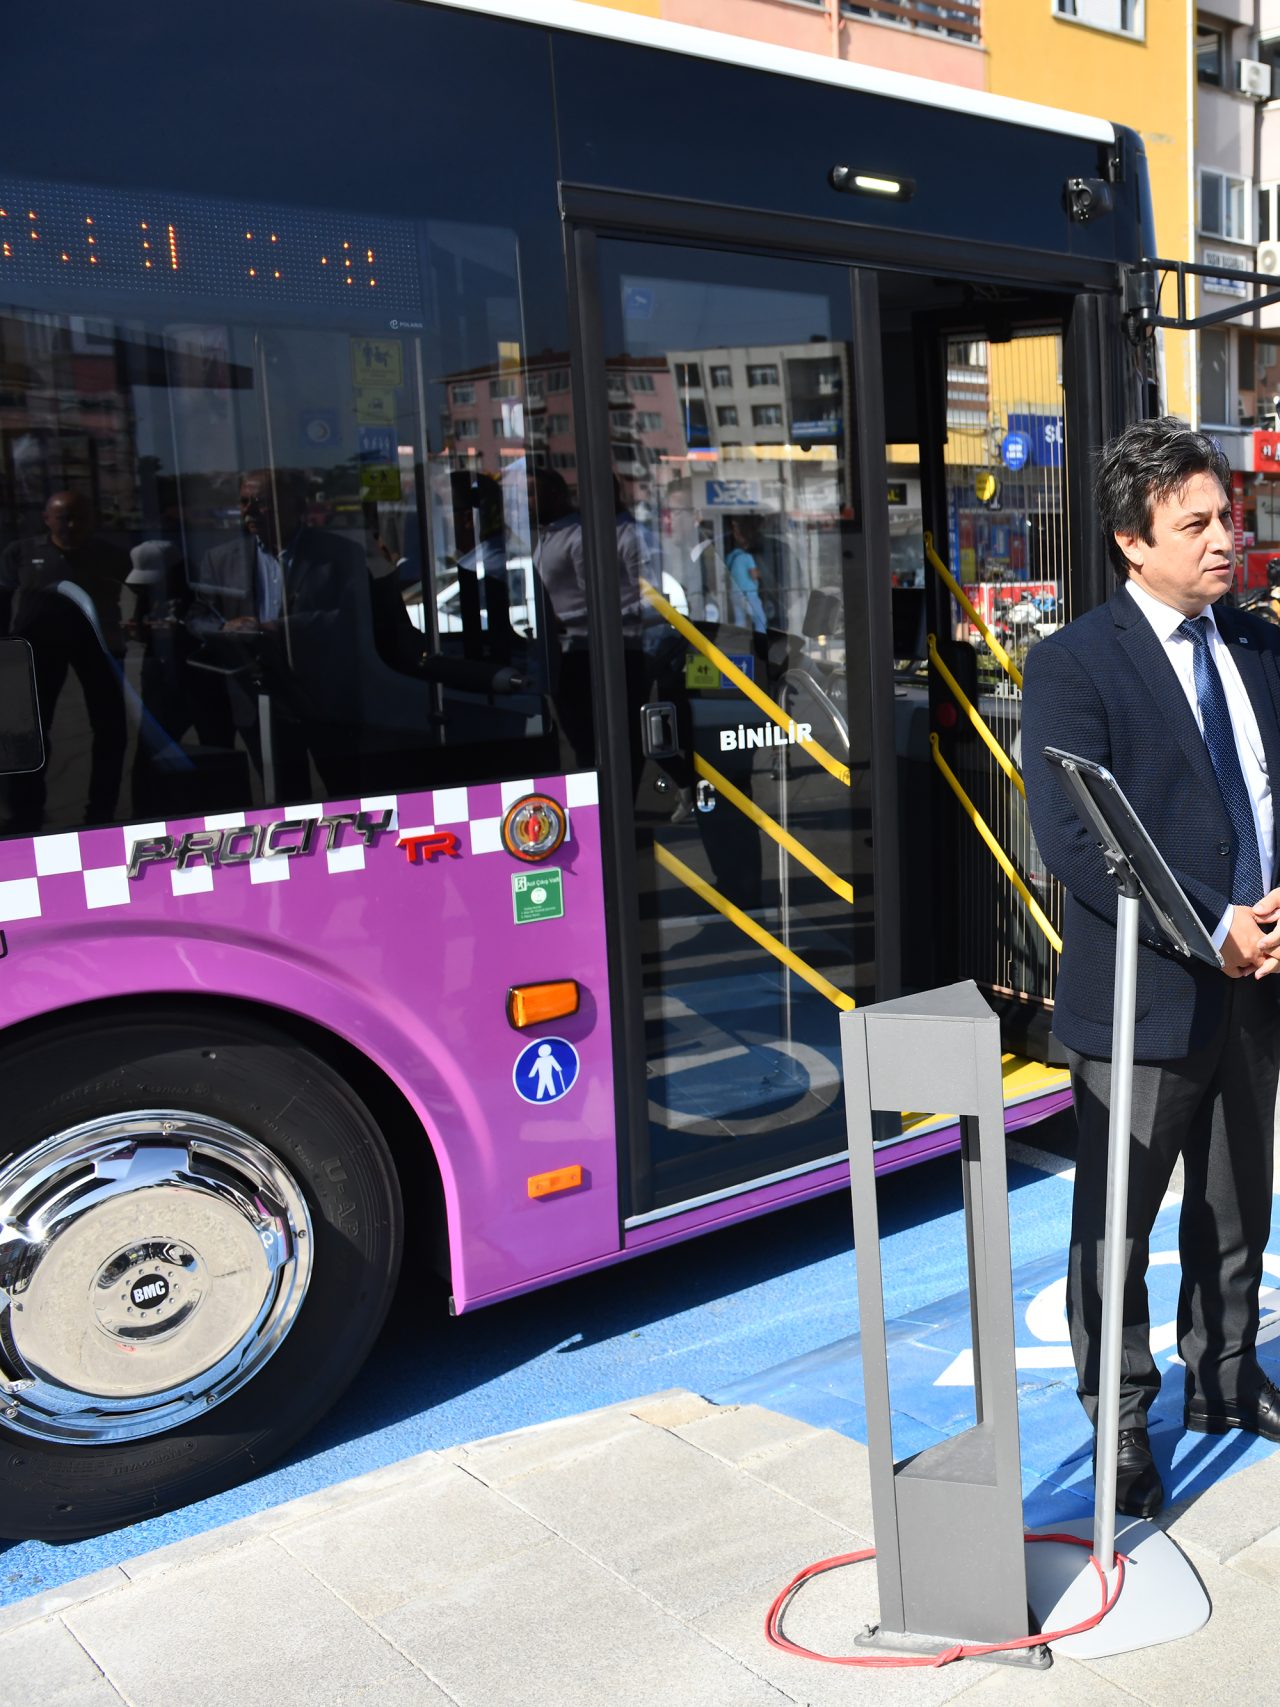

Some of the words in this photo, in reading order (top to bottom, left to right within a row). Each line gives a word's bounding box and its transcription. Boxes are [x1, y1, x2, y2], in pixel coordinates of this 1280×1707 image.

[720, 720, 813, 751] BİNİLİR
[126, 808, 394, 879] PROCITY
[397, 831, 461, 863] TR
[132, 1281, 166, 1304] BMC
